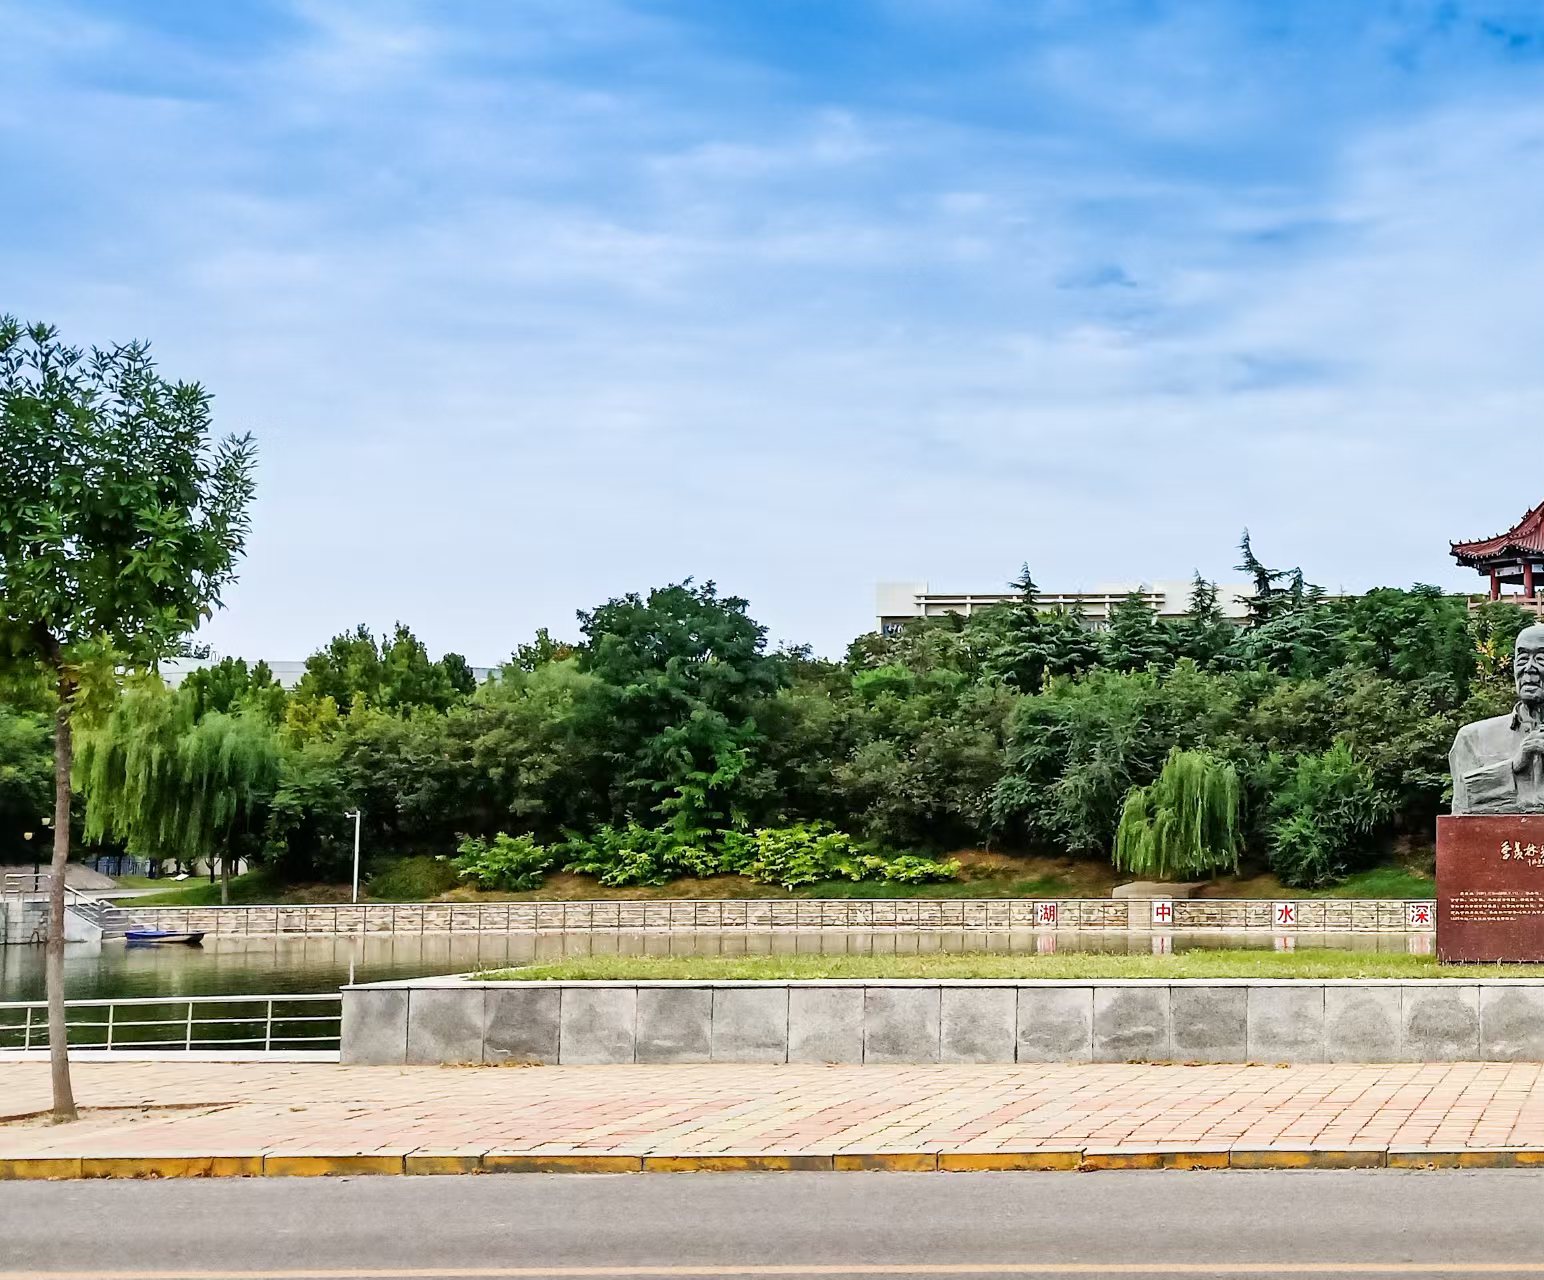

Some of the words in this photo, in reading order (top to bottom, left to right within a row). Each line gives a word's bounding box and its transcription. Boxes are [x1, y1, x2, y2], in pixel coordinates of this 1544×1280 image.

[1156, 903, 1171, 921] 中
[1278, 905, 1294, 923] 水
[1411, 905, 1429, 923] 深
